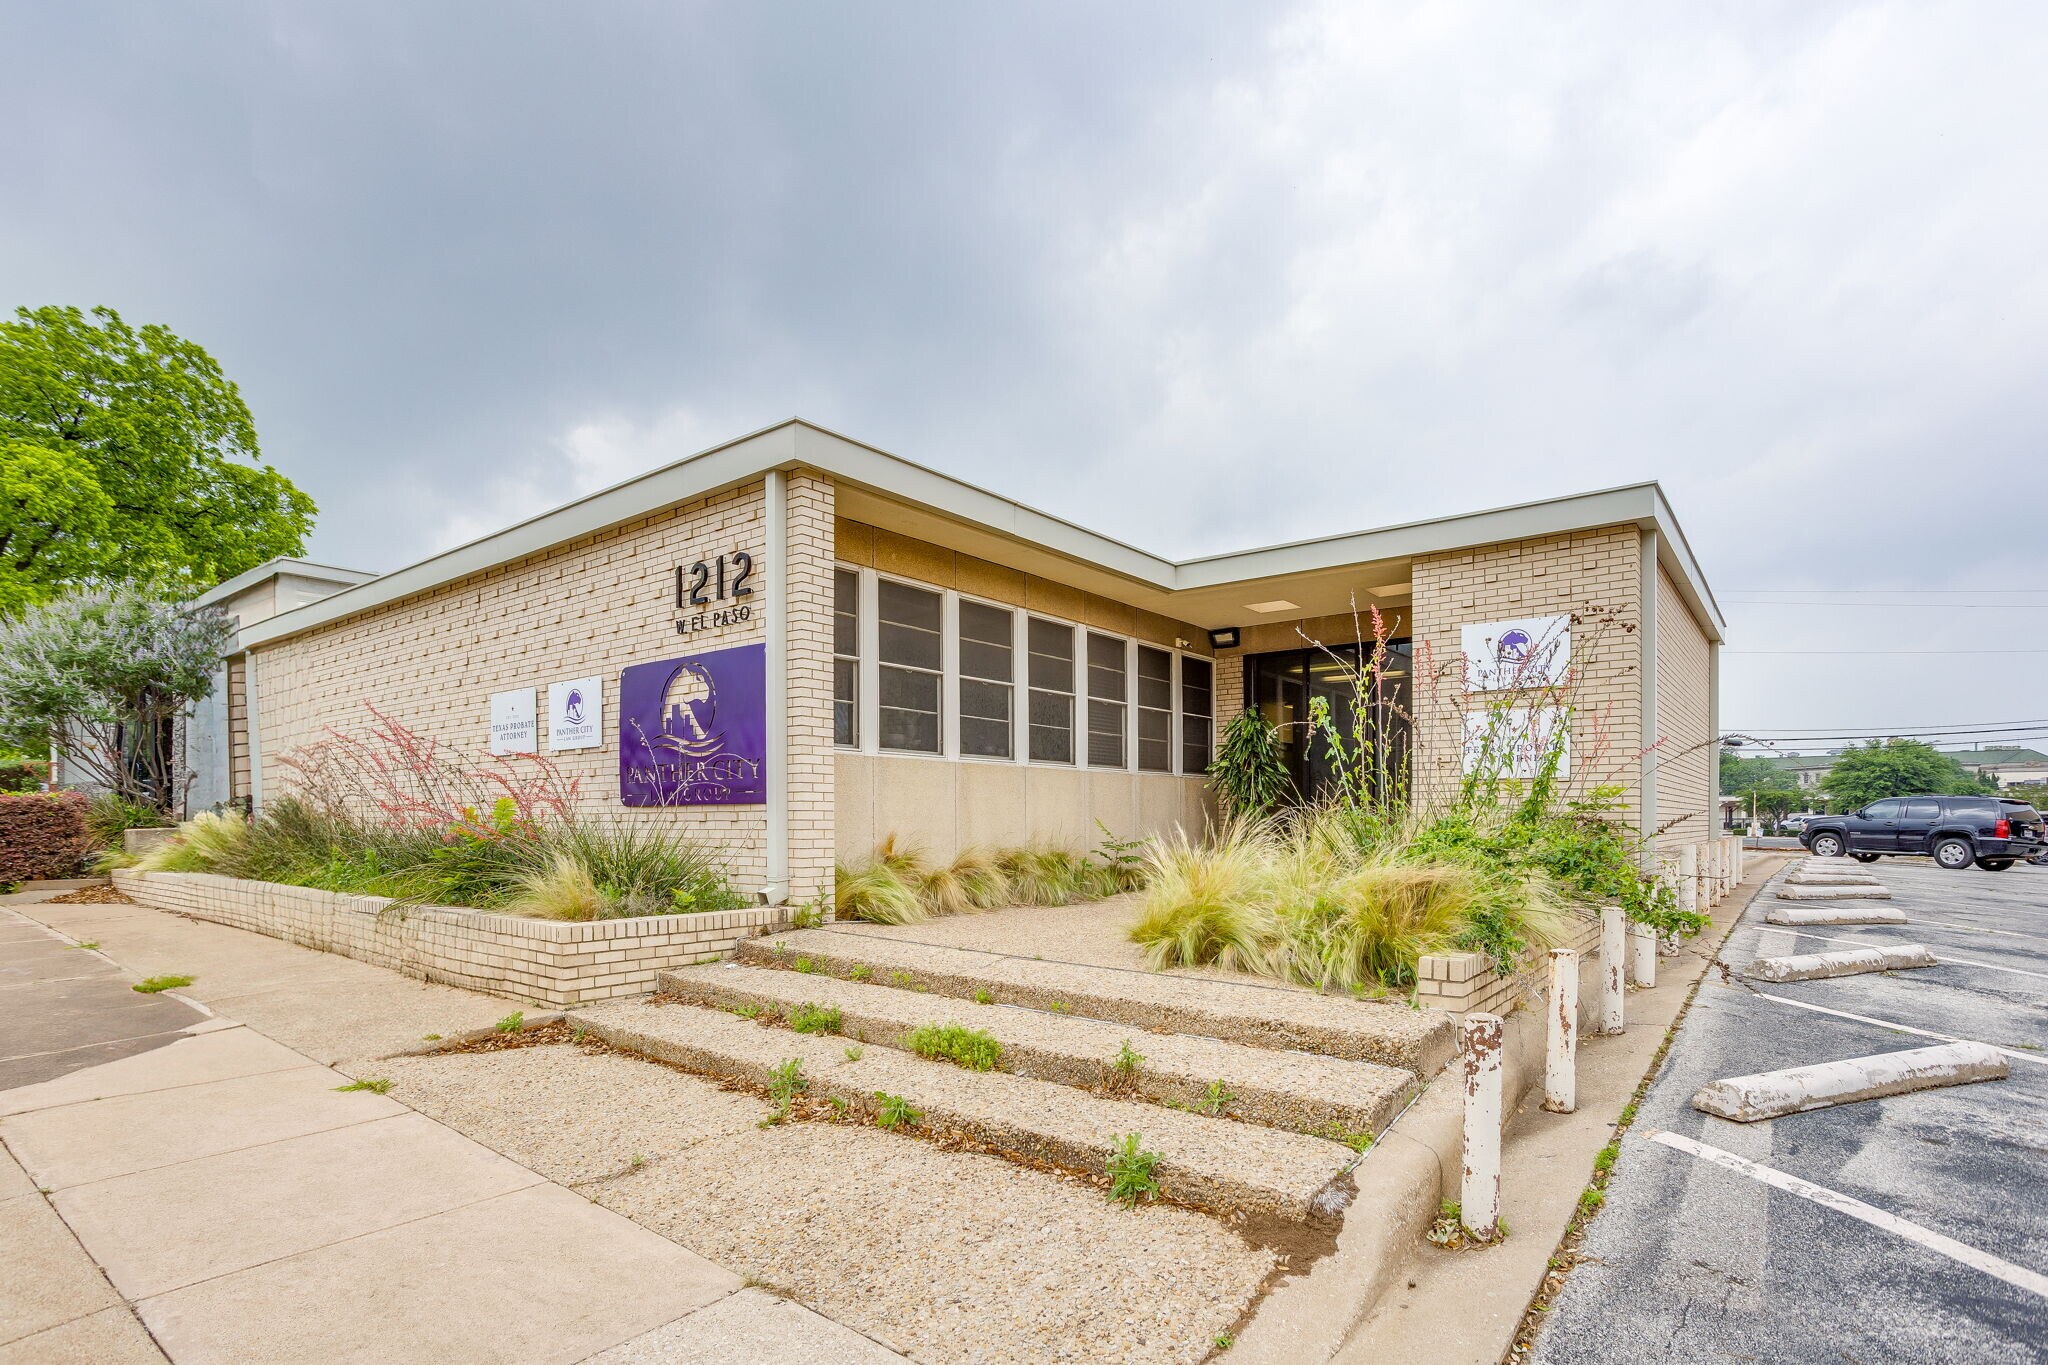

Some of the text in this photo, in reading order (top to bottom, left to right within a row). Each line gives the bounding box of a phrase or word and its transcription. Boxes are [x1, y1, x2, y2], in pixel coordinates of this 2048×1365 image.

[675, 552, 752, 608] 1212
[691, 615, 708, 631] EL
[713, 606, 750, 627] PASO
[492, 720, 535, 733] TEXAS PROBATE
[499, 730, 528, 741] ATTORNEY
[556, 725, 593, 737] PANTHER CITY
[626, 758, 761, 784] PANTHER CITY
